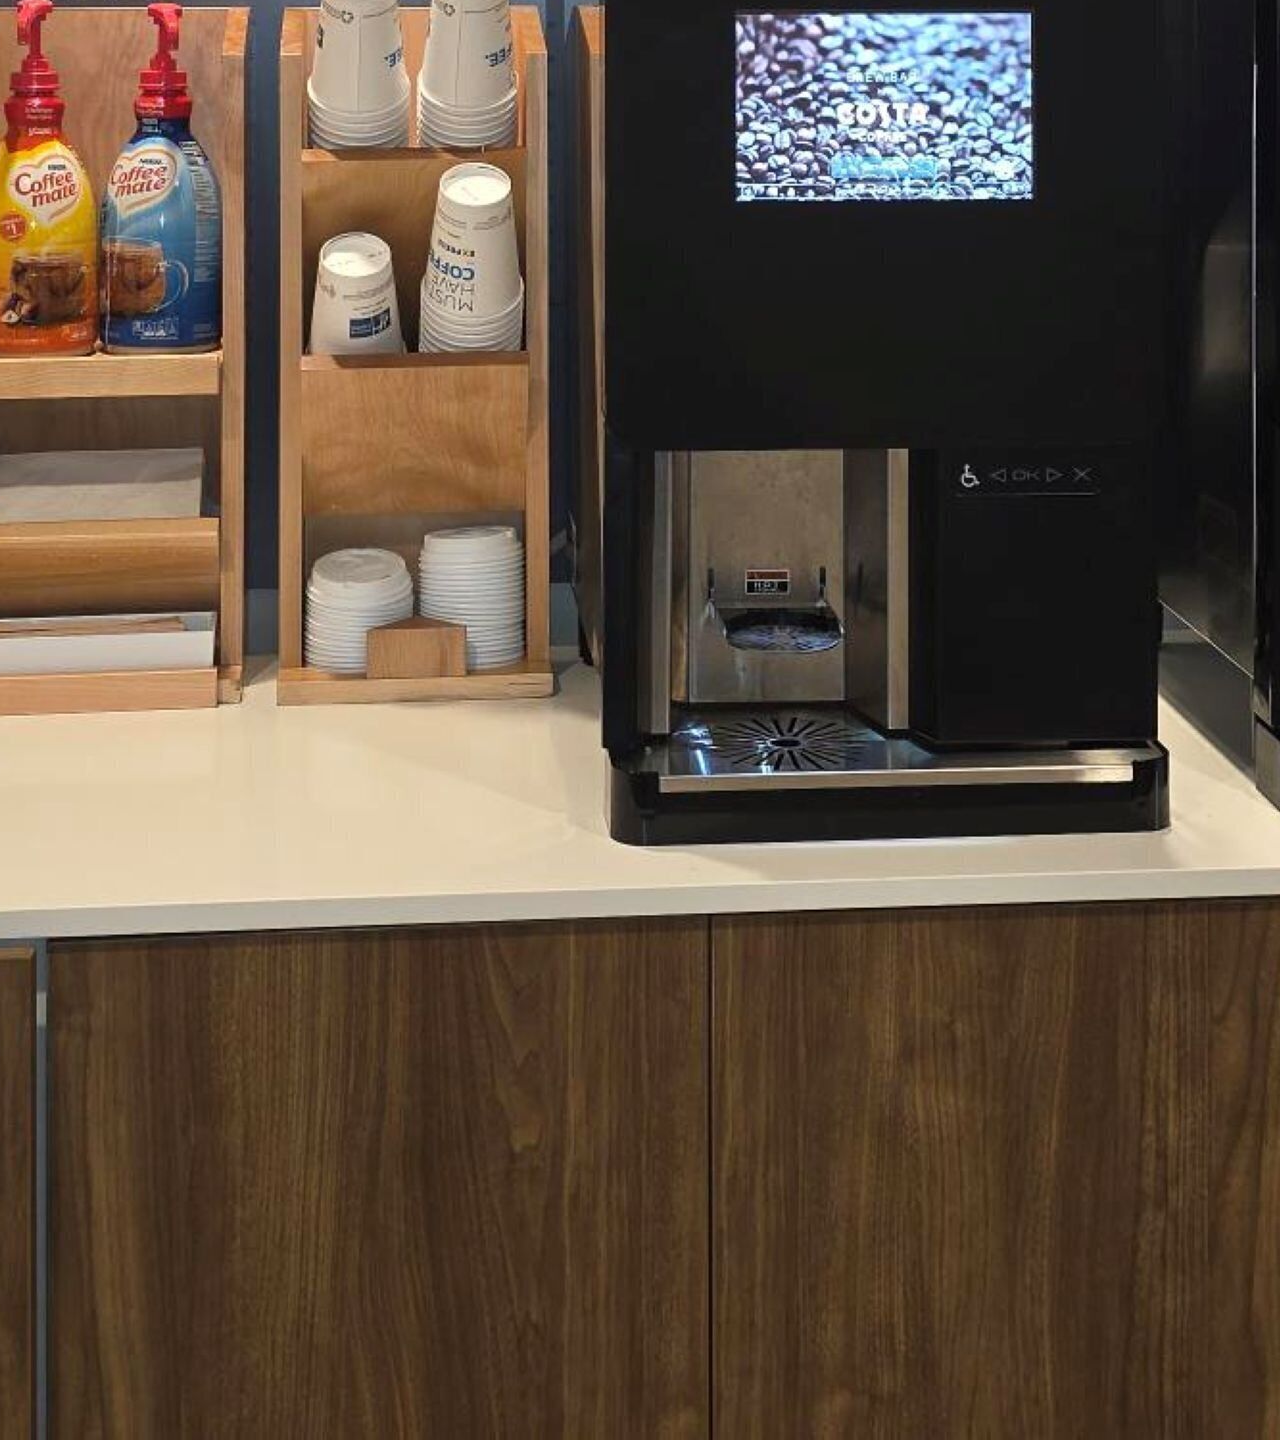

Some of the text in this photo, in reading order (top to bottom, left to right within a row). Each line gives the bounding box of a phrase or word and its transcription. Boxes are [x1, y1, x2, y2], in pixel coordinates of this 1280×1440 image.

[14, 171, 74, 196] Coffee
[110, 165, 167, 187] Coffee
[115, 176, 166, 198] mate
[31, 182, 78, 208] mate
